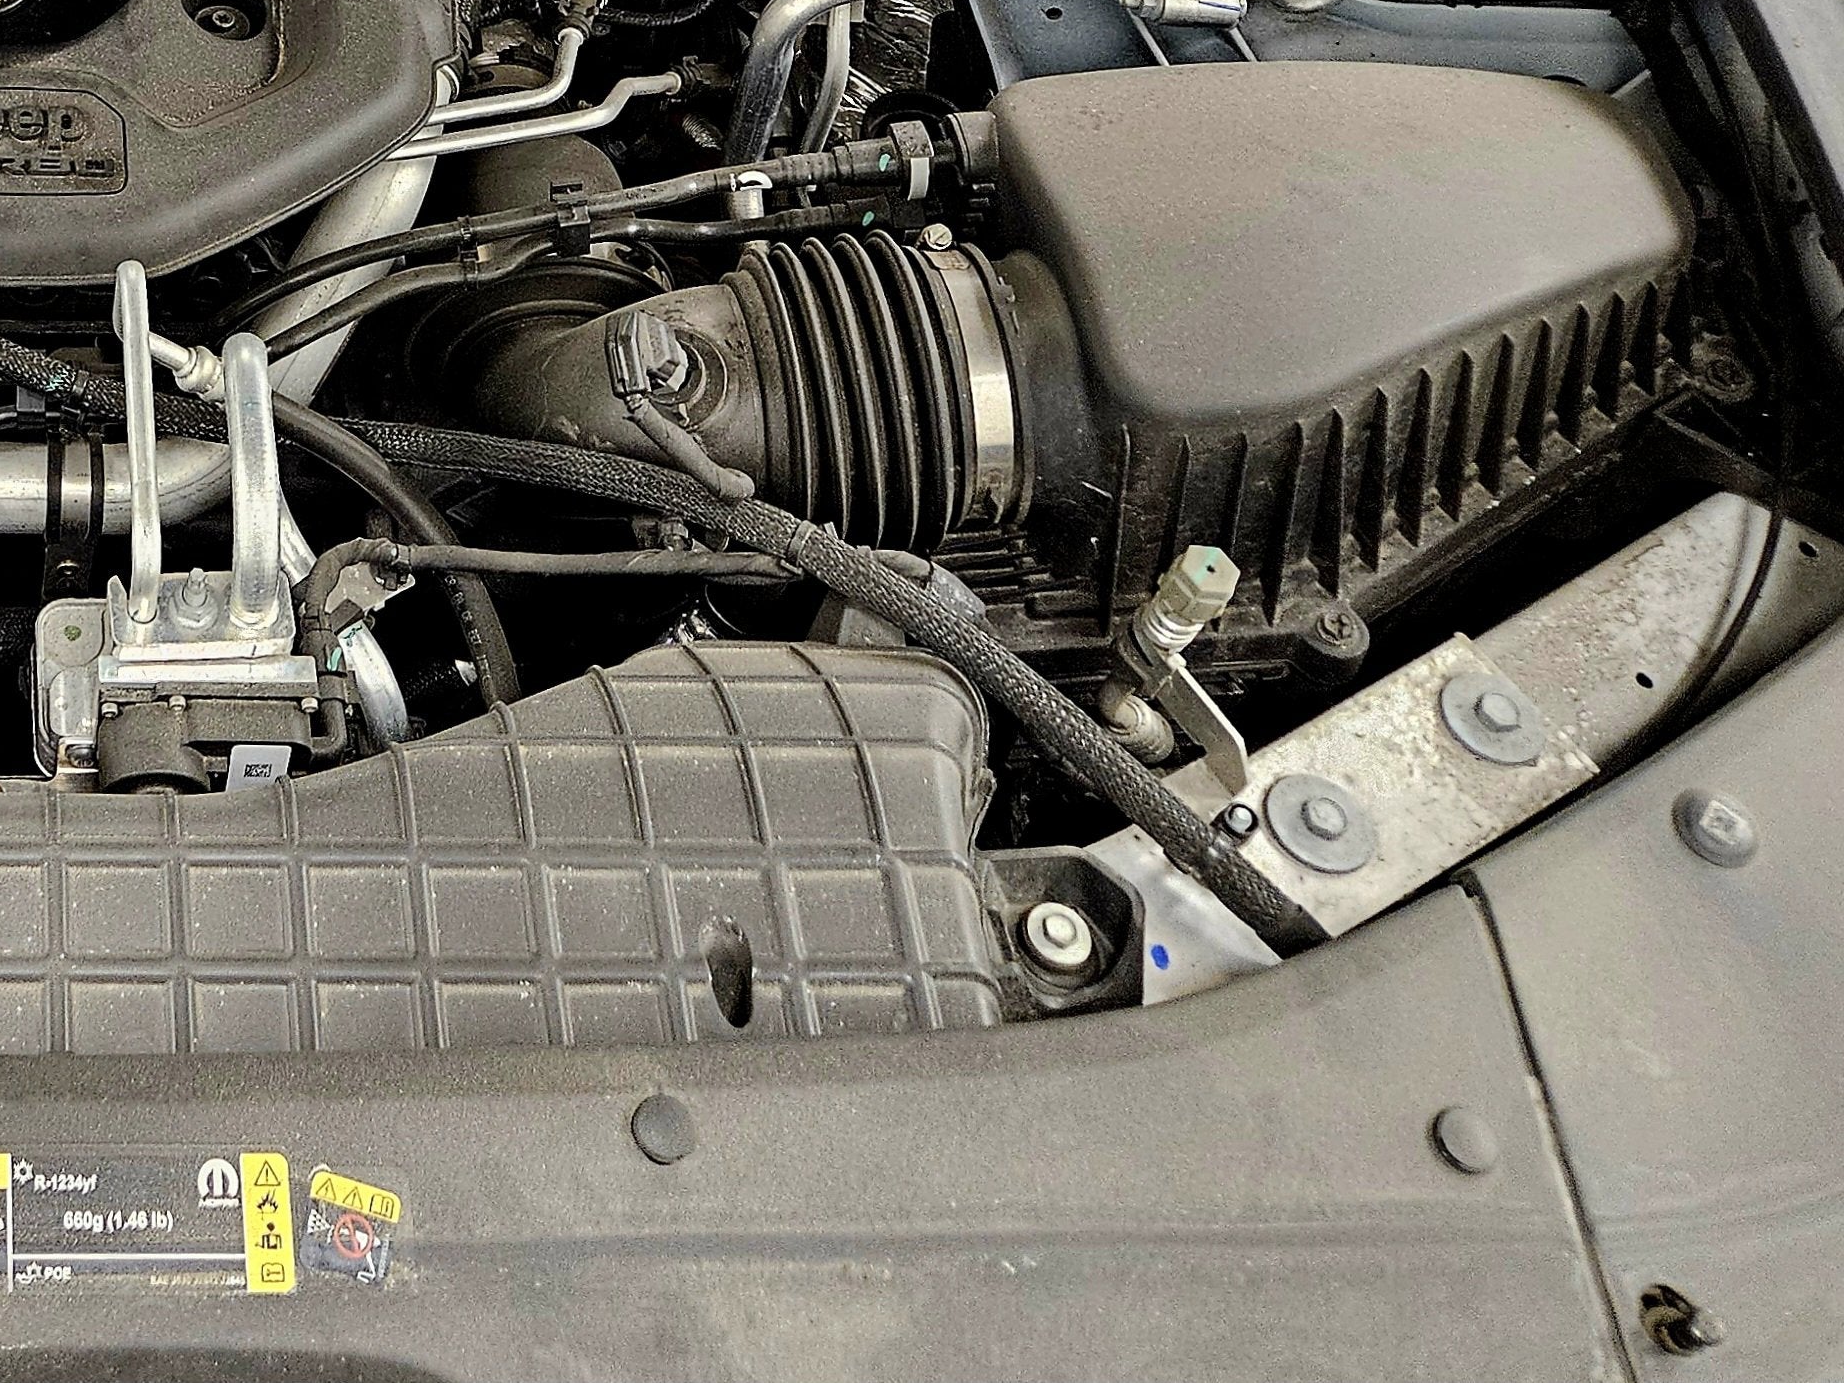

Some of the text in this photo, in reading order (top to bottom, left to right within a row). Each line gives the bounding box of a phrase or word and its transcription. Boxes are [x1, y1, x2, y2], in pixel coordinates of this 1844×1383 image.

[33, 1173, 98, 1195] R-1234yf
[63, 1210, 105, 1234] 660g
[151, 1210, 174, 1233] lb)
[44, 1266, 73, 1281] POE
